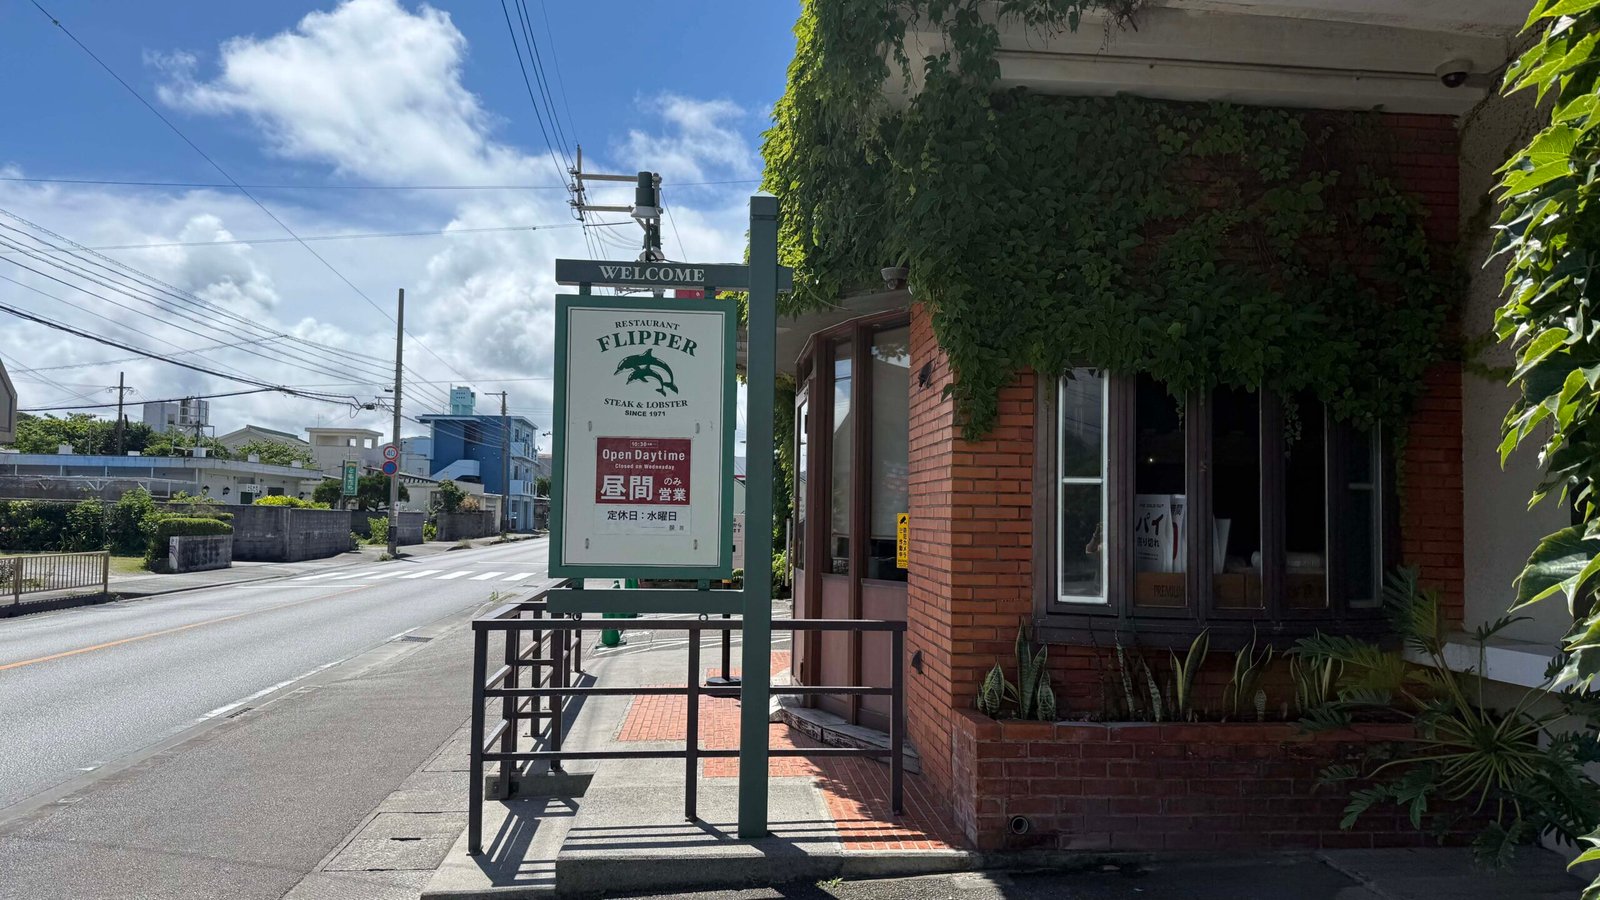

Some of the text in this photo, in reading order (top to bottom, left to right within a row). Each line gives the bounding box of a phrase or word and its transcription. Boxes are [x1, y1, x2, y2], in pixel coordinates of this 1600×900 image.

[598, 265, 705, 283] WELCOME
[615, 319, 680, 331] RESTAURANT
[596, 330, 698, 357] FLIPPER
[603, 398, 688, 409] STEAK & LOBSTER
[624, 409, 647, 417] SINCE
[386, 449, 396, 457] 40
[602, 448, 685, 463] Open Daytime
[644, 463, 675, 471] Wednesday
[600, 475, 654, 501] 昼間
[663, 477, 682, 486] のみ
[658, 487, 687, 502] 営業
[1136, 512, 1163, 535] パイ
